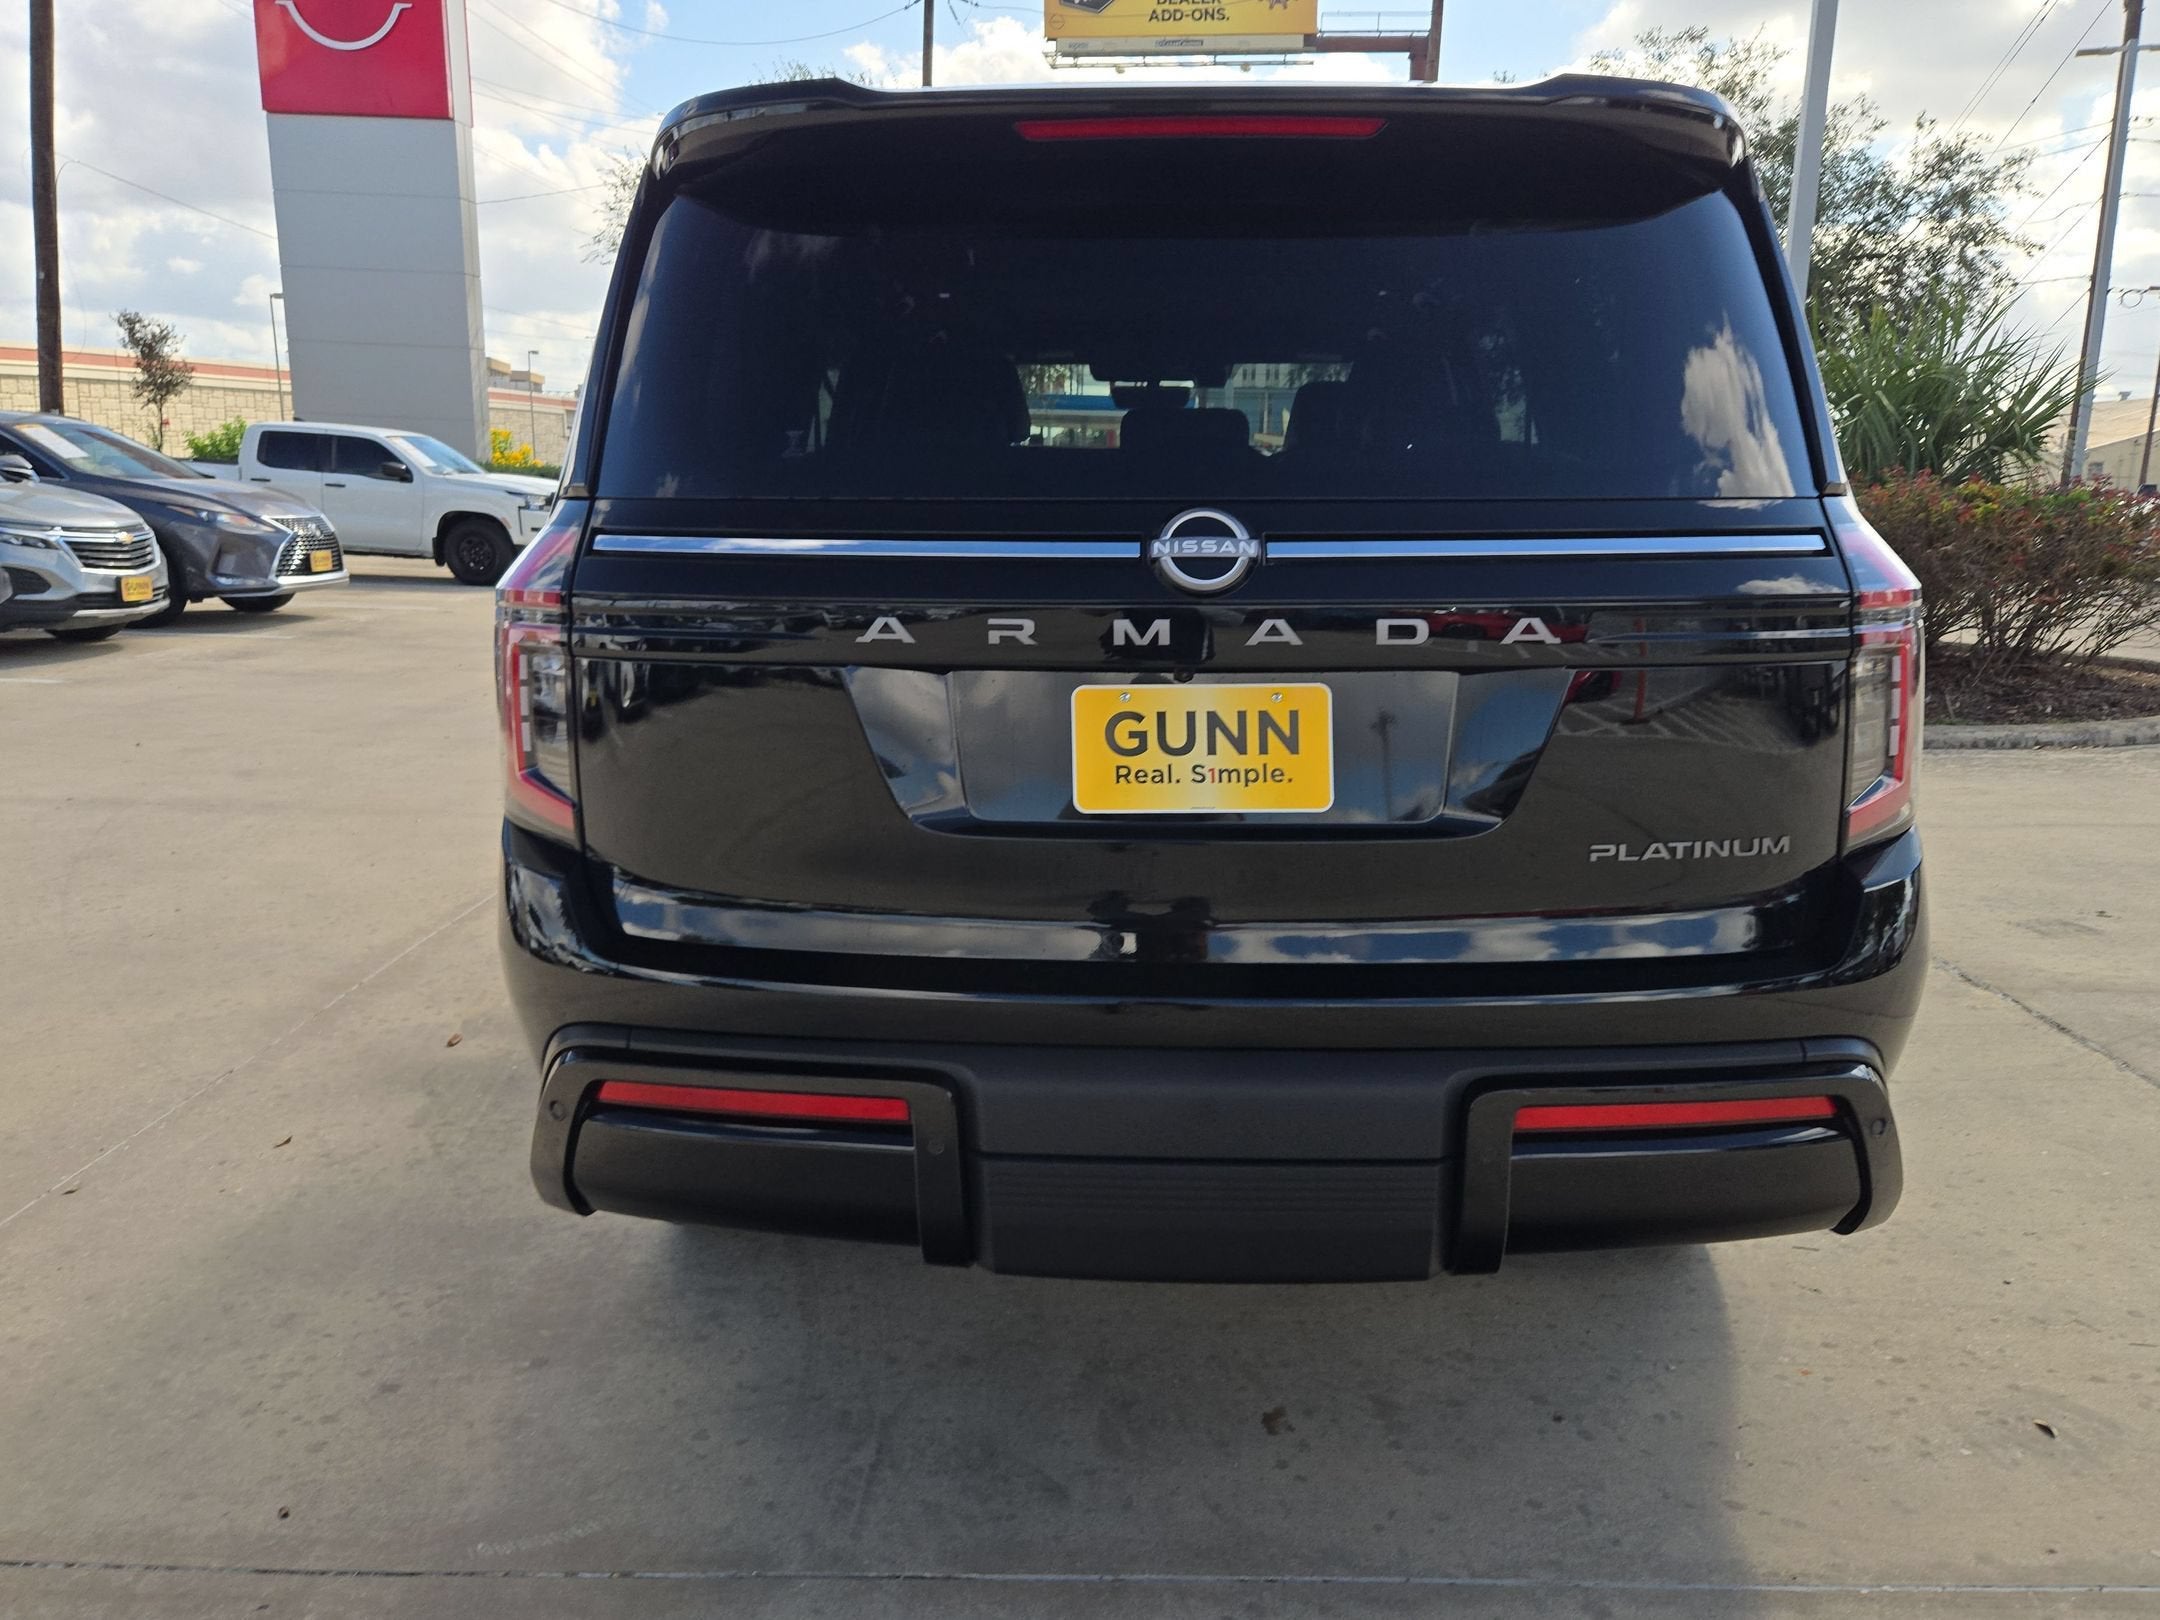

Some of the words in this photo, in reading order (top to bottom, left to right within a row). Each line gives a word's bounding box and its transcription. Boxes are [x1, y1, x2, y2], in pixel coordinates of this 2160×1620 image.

[1148, 8, 1230, 22] ADD-ONS.
[1153, 540, 1256, 555] NISSAN
[855, 617, 1561, 647] ARMADA
[1104, 709, 1300, 758] GUNN
[1115, 764, 1181, 785] Real.
[1589, 836, 1791, 862] PLATINUM
